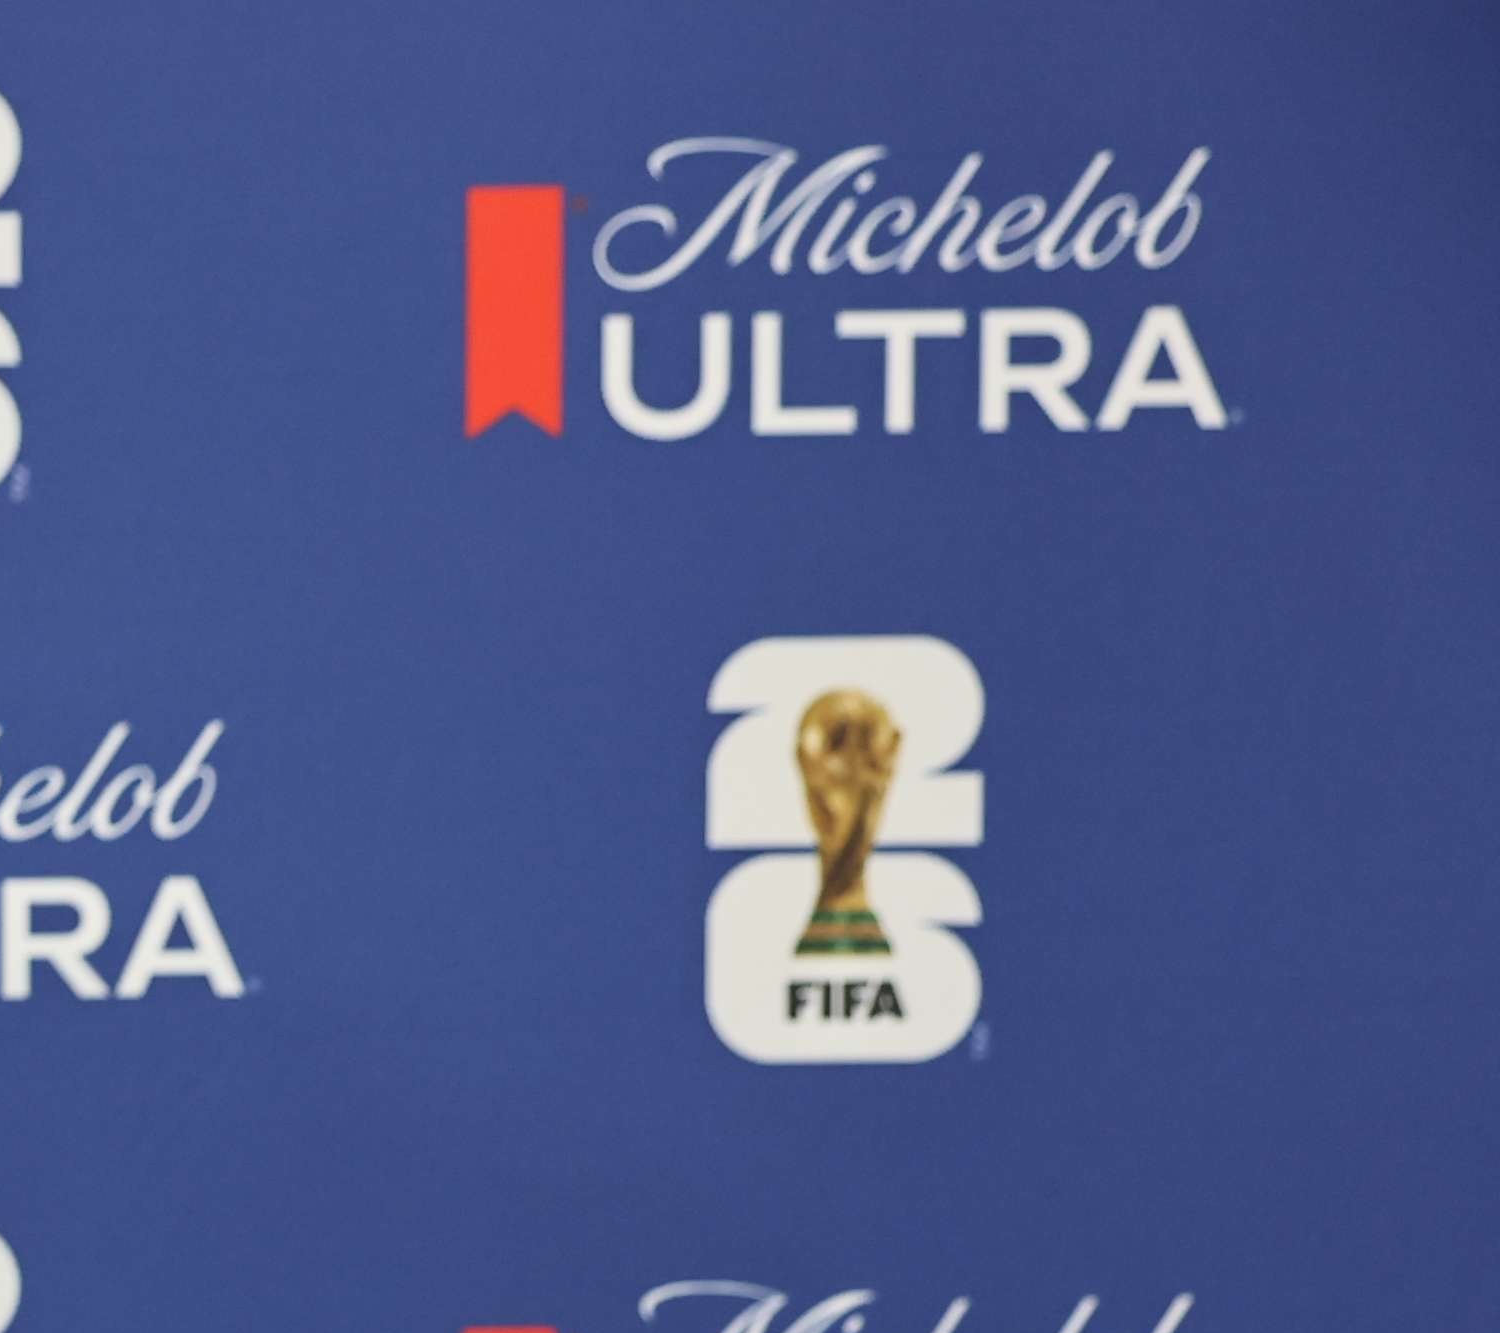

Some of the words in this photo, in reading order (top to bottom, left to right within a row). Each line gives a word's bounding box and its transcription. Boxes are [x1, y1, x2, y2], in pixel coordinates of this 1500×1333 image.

[592, 136, 1209, 292] Michelob
[600, 305, 1227, 442] ULTRA
[785, 979, 906, 1022] FIFA
